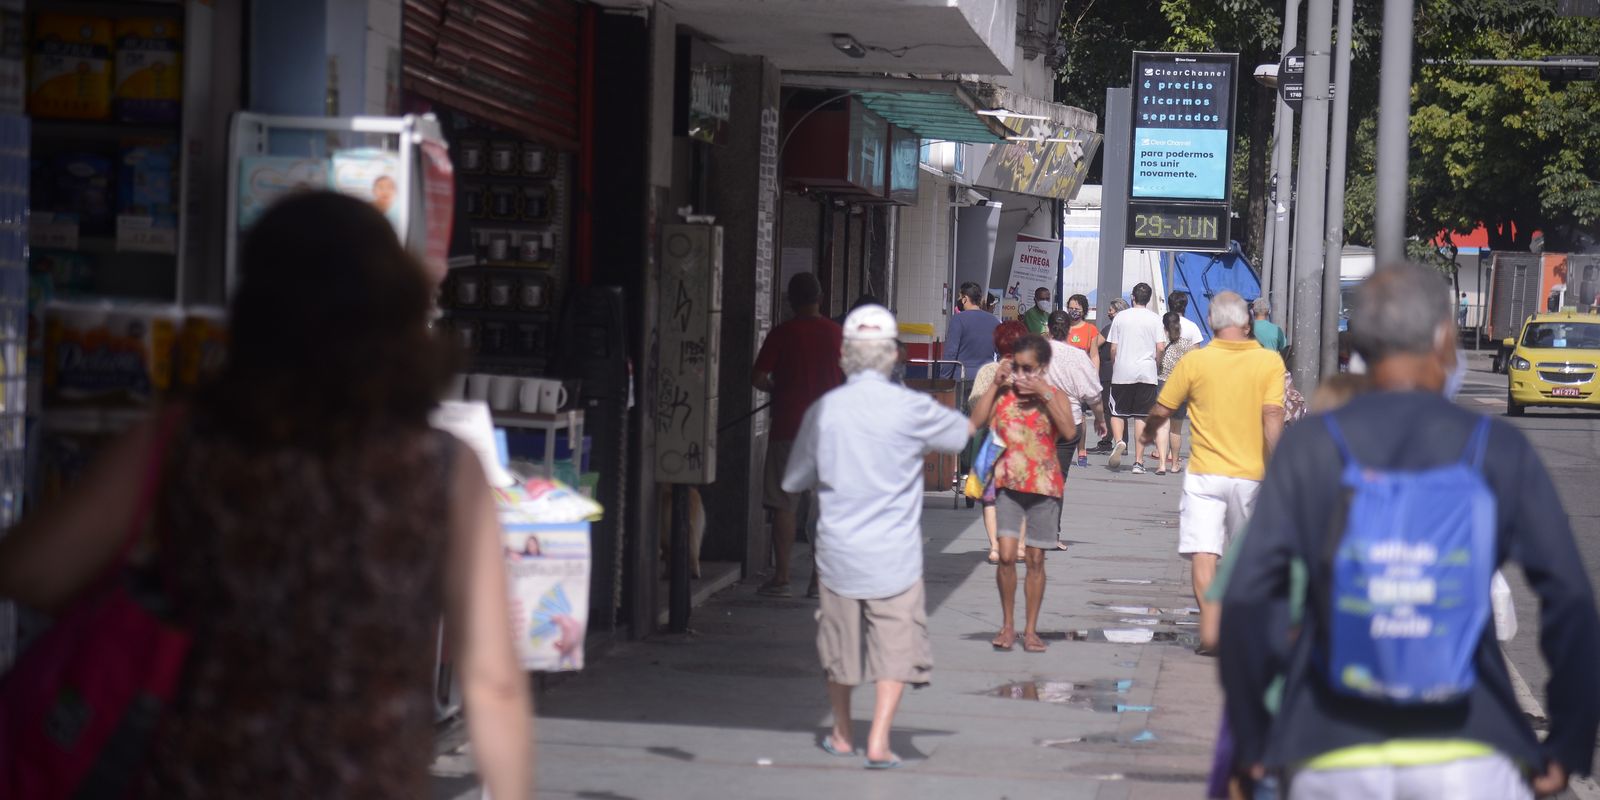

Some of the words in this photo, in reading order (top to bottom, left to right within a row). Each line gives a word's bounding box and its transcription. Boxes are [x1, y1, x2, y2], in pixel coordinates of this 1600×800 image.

[1144, 80, 1151, 89] é
[1158, 80, 1213, 90] preciso
[1143, 96, 1210, 105] ficarmos
[1142, 113, 1219, 122] separados
[1140, 150, 1163, 158] para
[1166, 150, 1214, 159] podermos
[1160, 159, 1180, 168] unir
[1140, 170, 1198, 178] novamente.
[1135, 214, 1218, 240] 29-JUN
[1020, 254, 1050, 267] ENTREGA
